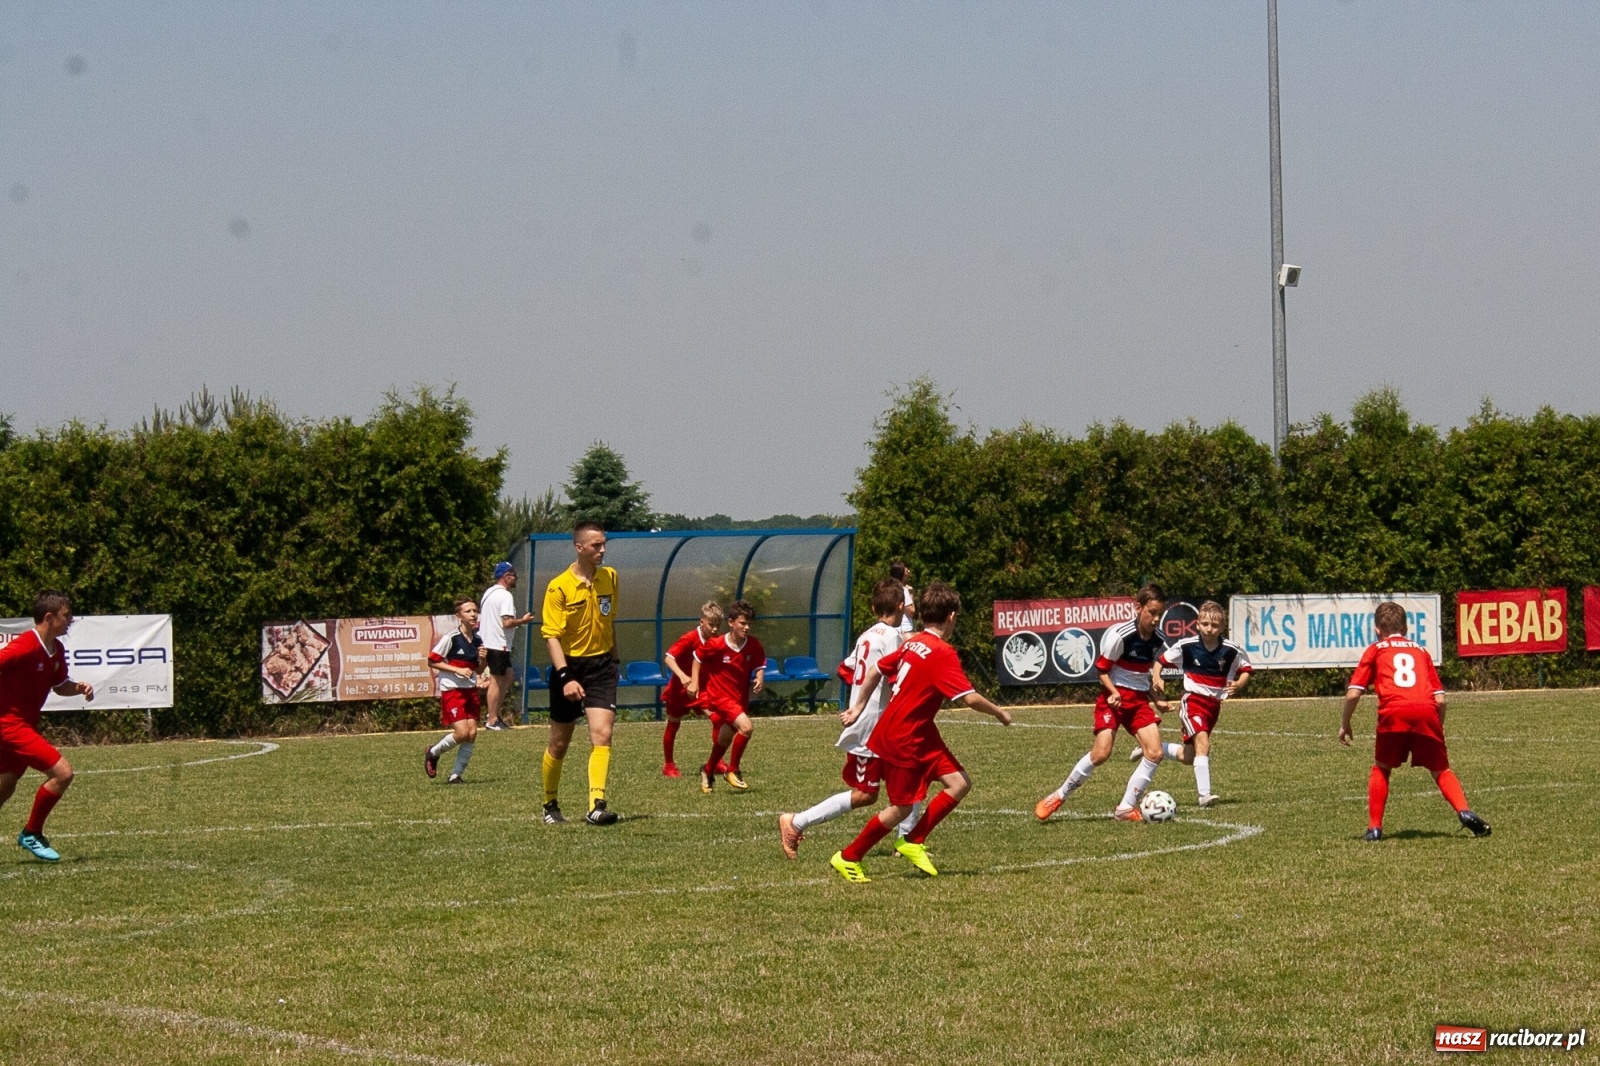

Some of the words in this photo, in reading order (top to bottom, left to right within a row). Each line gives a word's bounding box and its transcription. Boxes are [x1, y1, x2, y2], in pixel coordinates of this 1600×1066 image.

[998, 608, 1062, 631] RĘKAWICE
[1308, 611, 1427, 649] MARKOCE
[1460, 600, 1562, 645] KEBAB
[356, 629, 415, 640] PIWIARNIA
[1262, 640, 1279, 659] 07
[1393, 653, 1416, 688] 8
[367, 684, 379, 694] 32
[382, 683, 400, 693] 415
[403, 683, 414, 692] 14
[417, 682, 429, 692] 28
